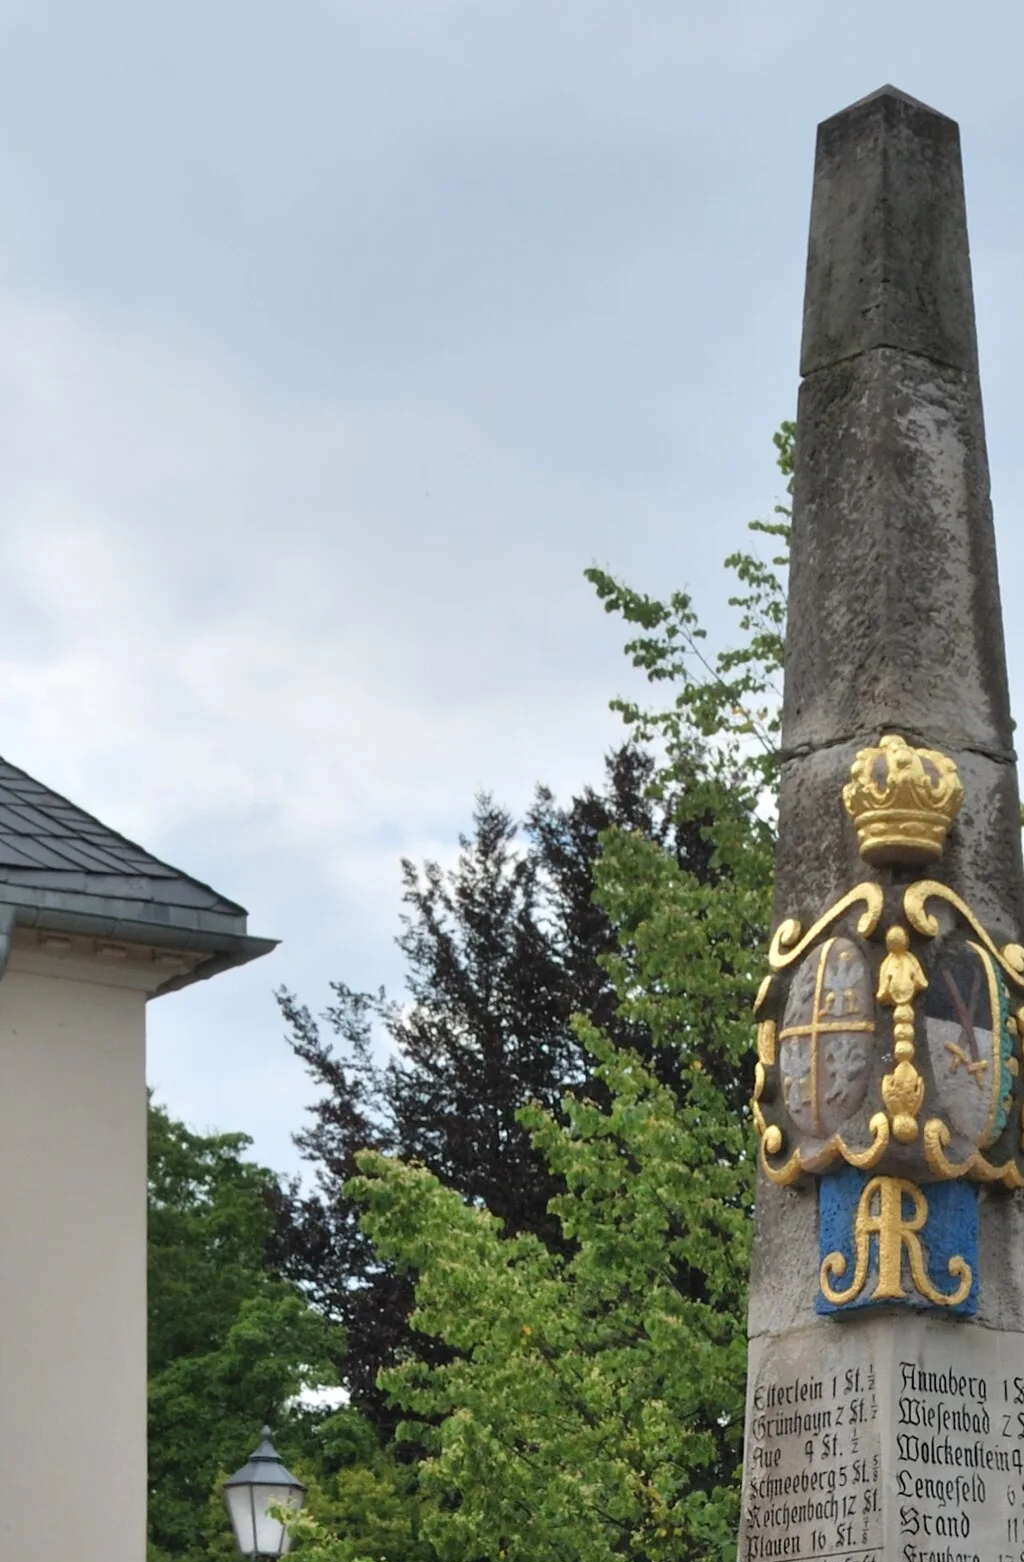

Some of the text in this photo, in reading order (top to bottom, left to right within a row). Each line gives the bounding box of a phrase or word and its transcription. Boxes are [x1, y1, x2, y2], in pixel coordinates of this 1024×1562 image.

[899, 1361, 988, 1404] Annaberg
[752, 1447, 782, 1470] Aue
[750, 1468, 836, 1502] Schneeberg
[839, 1467, 848, 1487] 5
[896, 1469, 987, 1509] Lengefeld
[745, 1493, 839, 1532] Reichenbach
[900, 1504, 971, 1539] Brand
